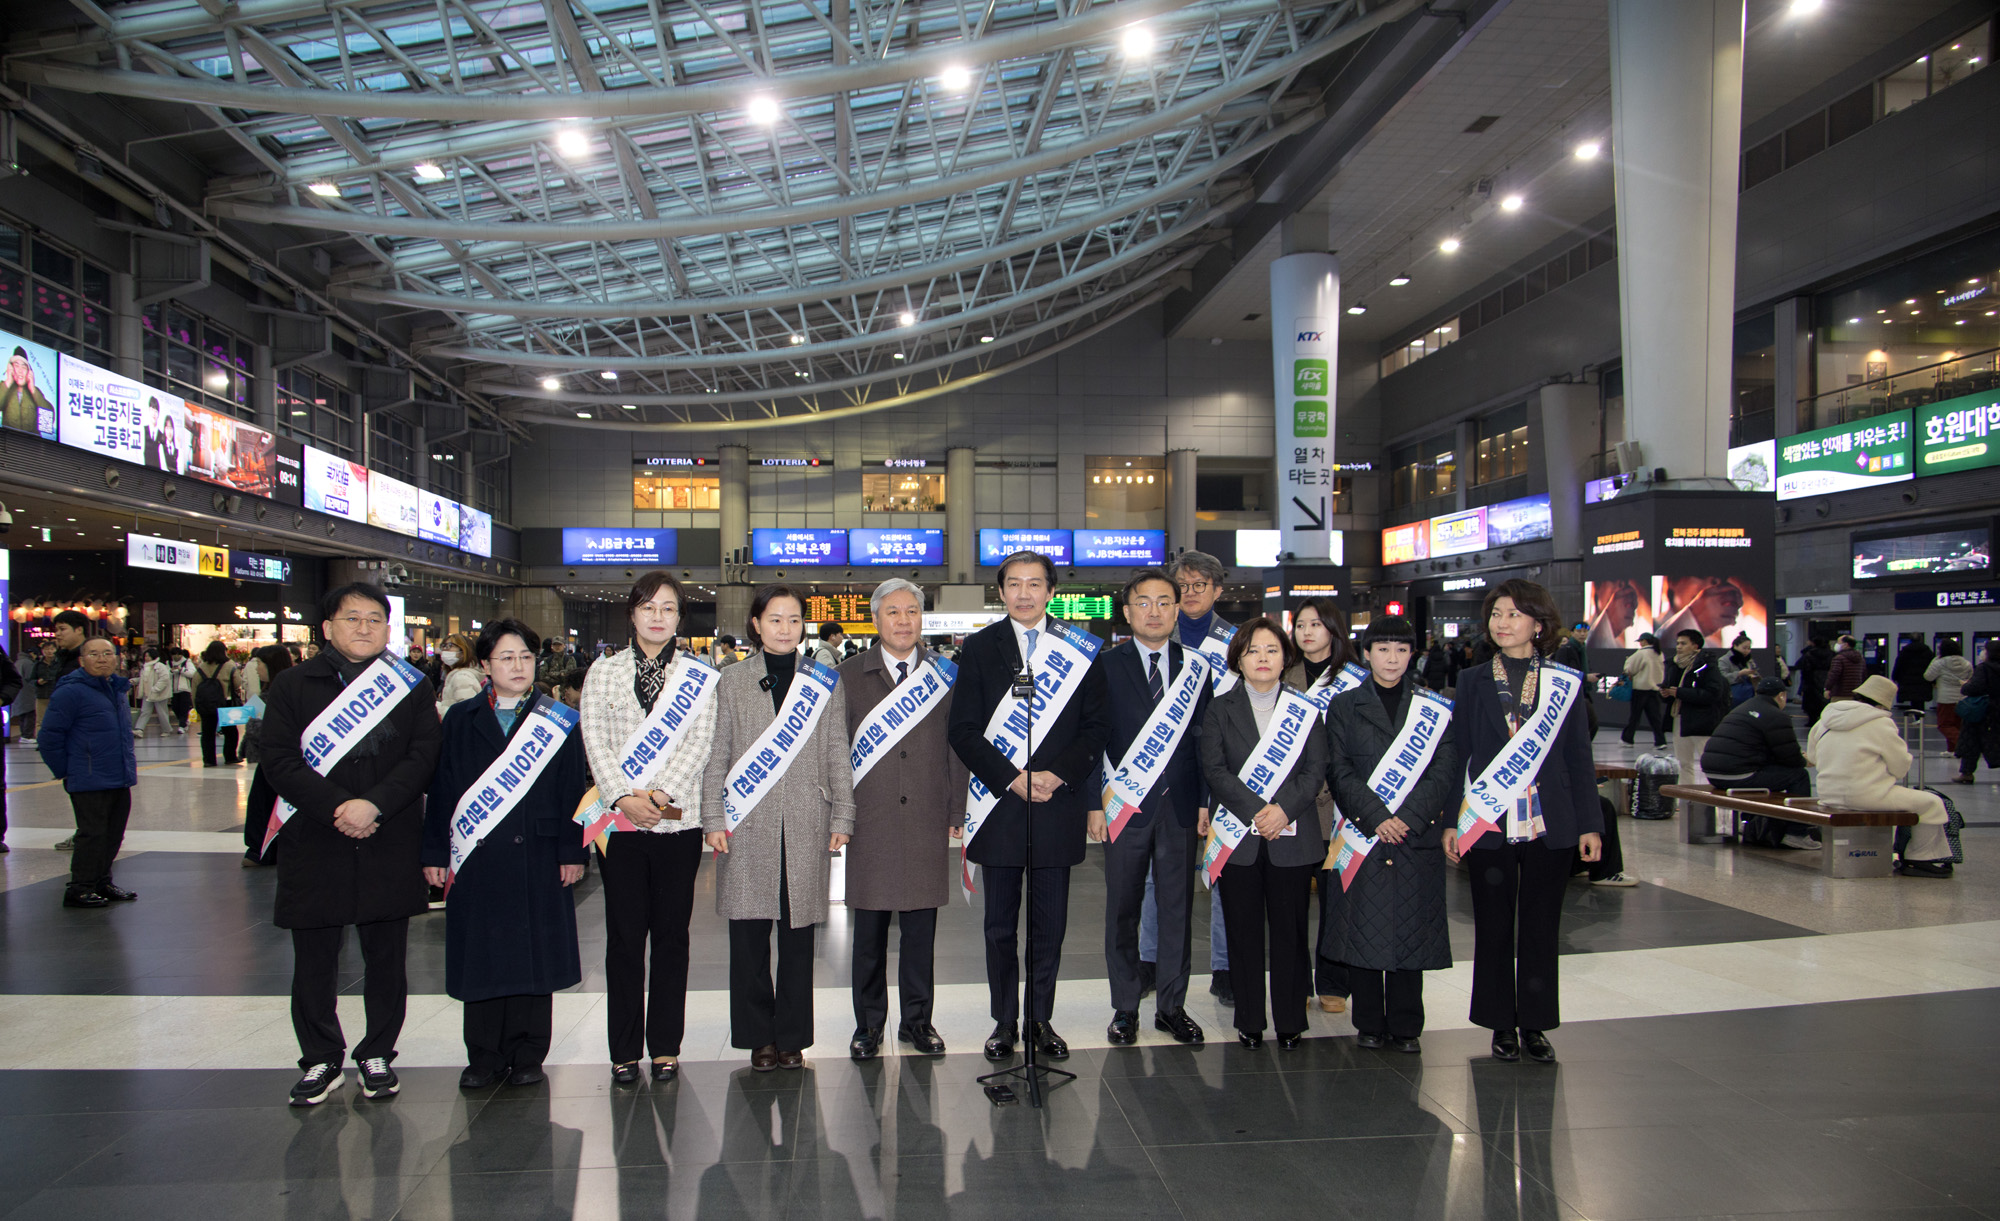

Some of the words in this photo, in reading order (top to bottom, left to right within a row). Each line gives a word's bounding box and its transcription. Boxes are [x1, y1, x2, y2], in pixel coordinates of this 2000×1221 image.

[1297, 330, 1326, 342] KTX
[68, 377, 85, 390] 이제는
[94, 383, 105, 393] 시대
[1301, 381, 1321, 391] 새마을
[68, 392, 142, 426] 전북인공지능
[1297, 411, 1325, 423] 무궁화
[94, 425, 142, 450] 고등학교
[1782, 441, 1820, 463] 색깔있는
[1822, 432, 1853, 456] 인재를
[1854, 427, 1887, 448] 키우는
[647, 458, 693, 466] LOTTERIA
[1289, 469, 1316, 485] 타는
[1320, 469, 1330, 486] 곳
[279, 470, 297, 487] 09:14
[1784, 482, 1798, 491] HU
[598, 537, 655, 550] JB금융그룹
[784, 542, 831, 555] 전북은행
[880, 542, 927, 555] 광주은행
[1096, 549, 1152, 559] JB인베스트먼트
[1102, 536, 1146, 545] JB자산운용
[216, 555, 222, 569] 2
[1950, 592, 1967, 601] 승차권
[1980, 590, 1988, 599] 곳
[1053, 622, 1096, 653] 조국혁신당
[385, 654, 417, 684] 조국혁신당
[802, 663, 834, 686] 조국혁신당
[327, 673, 397, 740] 혁신으로
[660, 666, 708, 731] 혁신으로
[881, 671, 940, 731] 혁신으로
[1003, 649, 1074, 741] 혁신으로
[1165, 658, 1203, 725] 혁신으로
[537, 704, 572, 729] 조국혁신당
[772, 684, 820, 753] 혁신으로
[1534, 676, 1572, 742] 혁신으로
[303, 732, 337, 769] 희망
[850, 722, 889, 772] 희망찬
[1132, 722, 1176, 774] 희망찬
[1263, 702, 1308, 767] 혁신으로
[1395, 704, 1440, 772] 혁신으로
[494, 724, 554, 793] 혁신으로
[620, 726, 669, 779] 희망찬
[1492, 738, 1542, 790] 희망찬
[732, 747, 782, 799] 희망찬
[1114, 766, 1145, 797] 2026
[1246, 763, 1275, 797] 희망
[1375, 767, 1407, 806] 희망
[456, 785, 505, 840] 희망찬
[1471, 780, 1505, 814] 2026
[1214, 807, 1244, 839] 2026
[1848, 849, 1878, 858] KORAIL
